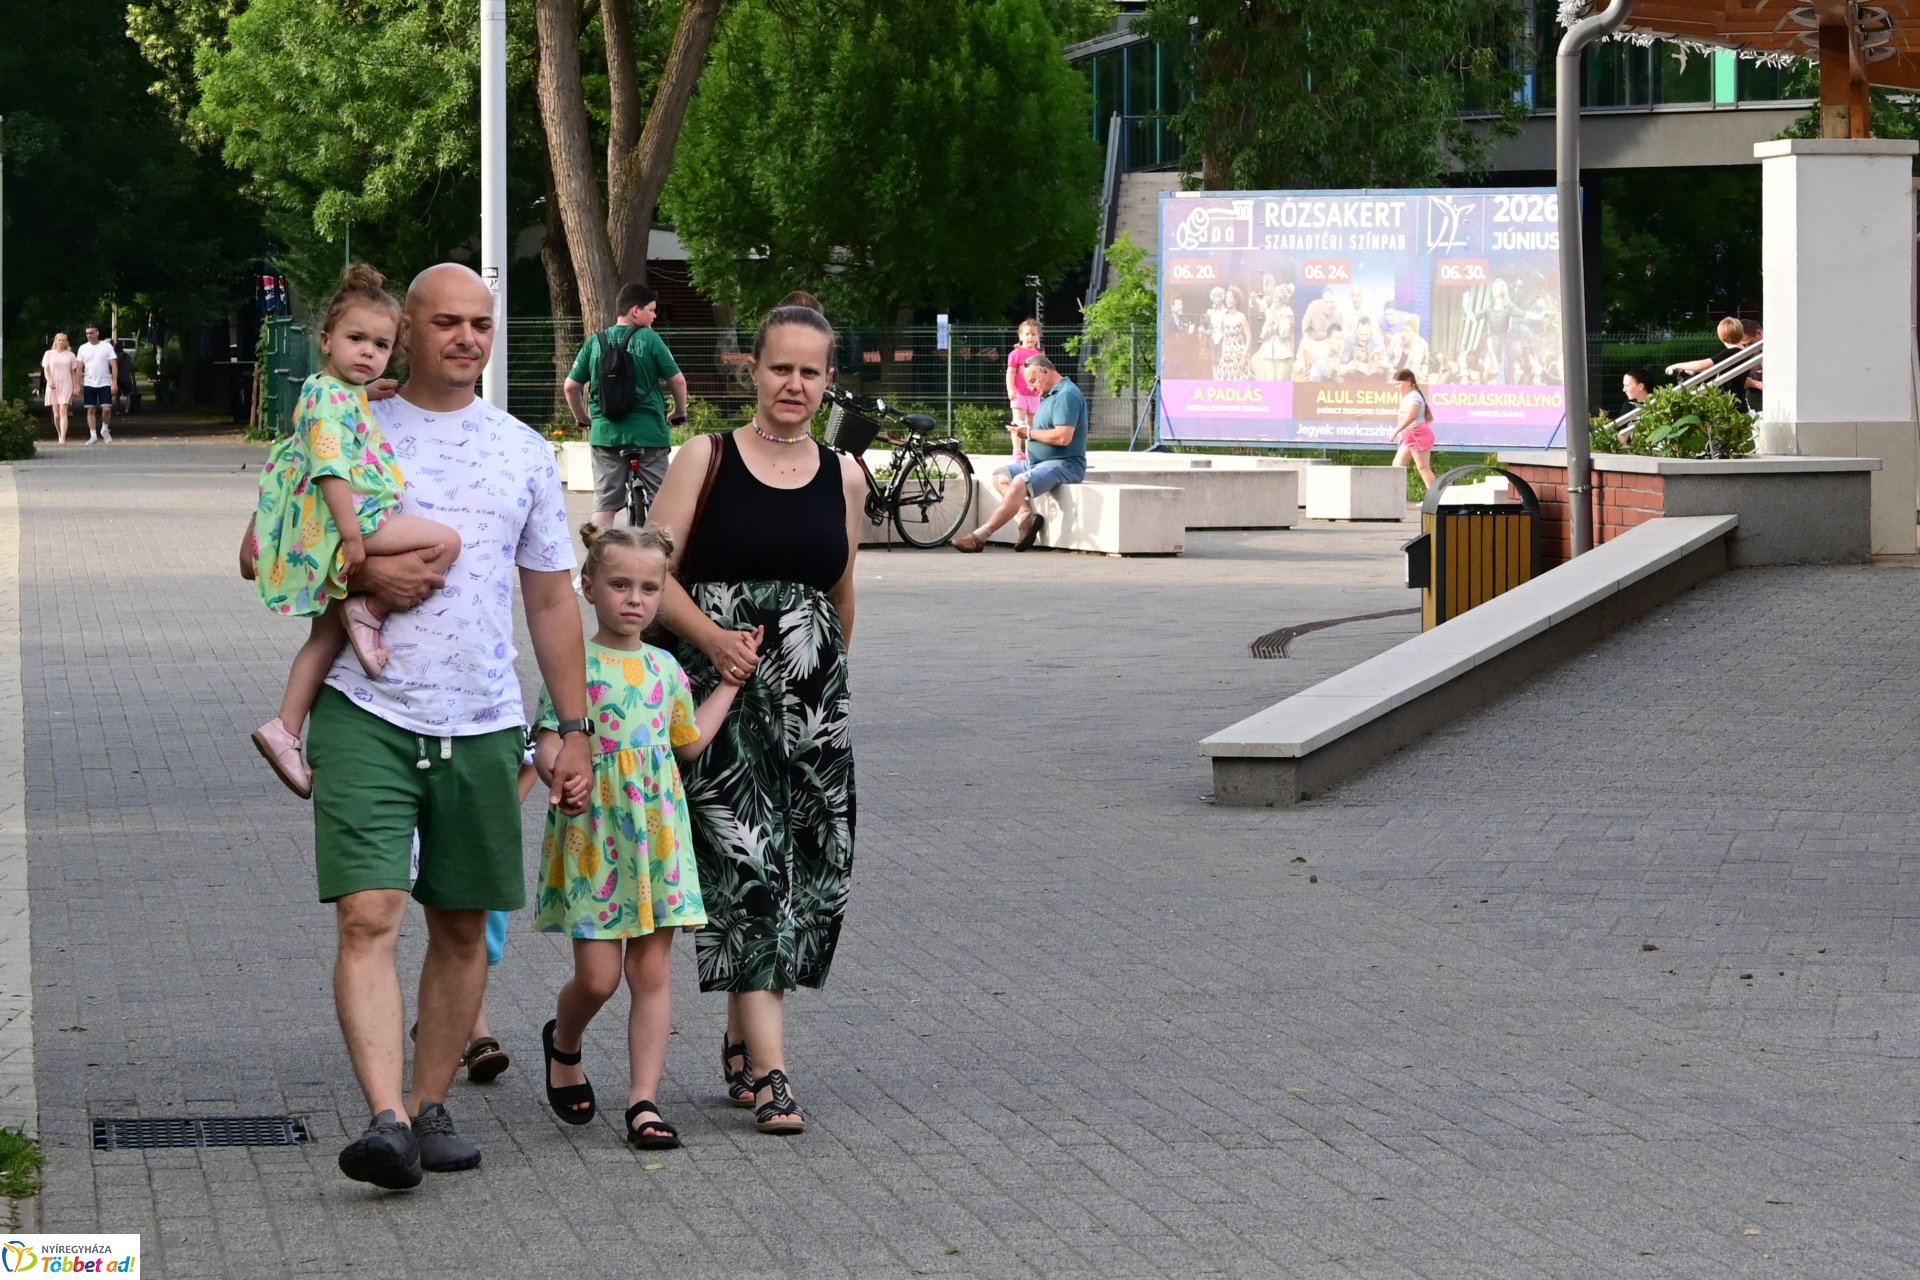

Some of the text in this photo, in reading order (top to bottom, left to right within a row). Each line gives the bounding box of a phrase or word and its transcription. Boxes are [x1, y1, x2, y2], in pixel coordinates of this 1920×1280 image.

[1265, 198, 1406, 228] RÓZSAKERT
[1493, 195, 1558, 222] 2026
[1265, 231, 1406, 250] SZABADTÉRI SZÍNPAD
[1492, 227, 1560, 250] JÚNIUS
[1173, 265, 1215, 279] 06. 20.
[1305, 265, 1348, 279] 06. 24.
[1441, 265, 1486, 279] 06. 30.
[1194, 386, 1261, 401] A PADLÁS
[1316, 390, 1353, 404] ALUL
